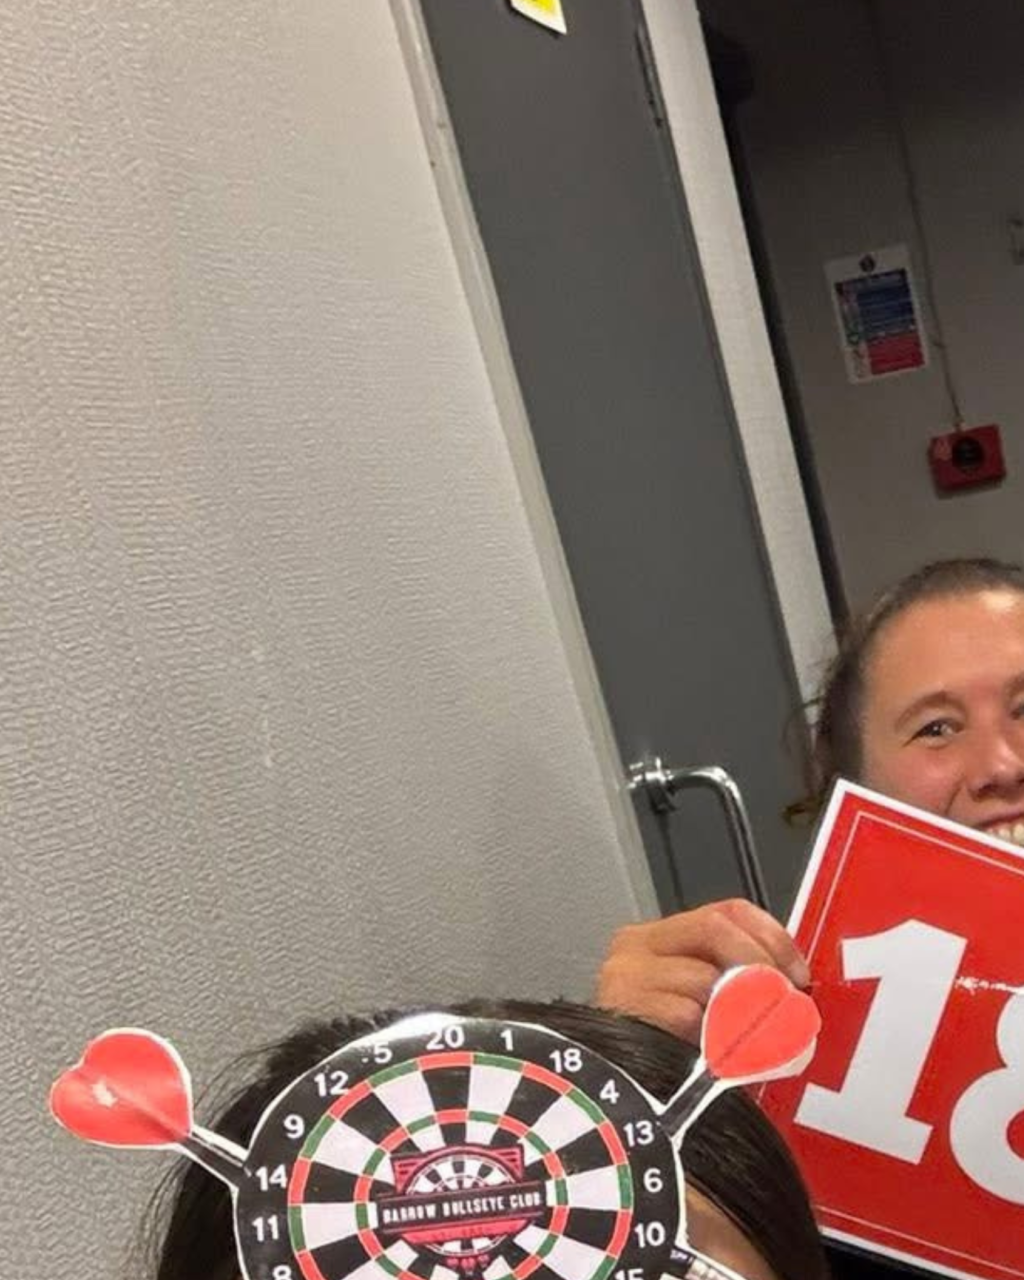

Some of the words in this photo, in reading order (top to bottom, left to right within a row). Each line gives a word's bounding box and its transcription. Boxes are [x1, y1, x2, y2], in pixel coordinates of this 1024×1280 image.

[426, 1025, 465, 1051] 20
[501, 1026, 514, 1052] 1
[373, 1041, 393, 1064] 5
[549, 1047, 584, 1074] 18
[313, 1070, 349, 1098] 12
[599, 1078, 621, 1105] 4
[283, 1113, 305, 1140] 9
[623, 1119, 655, 1148] 13
[255, 1163, 288, 1192] 14
[643, 1167, 664, 1194] 6
[382, 1203, 436, 1224] BARROW
[442, 1196, 504, 1217] BULLSEYE
[509, 1191, 541, 1209] CLUB
[251, 1214, 280, 1243] 11
[634, 1221, 666, 1249] 10
